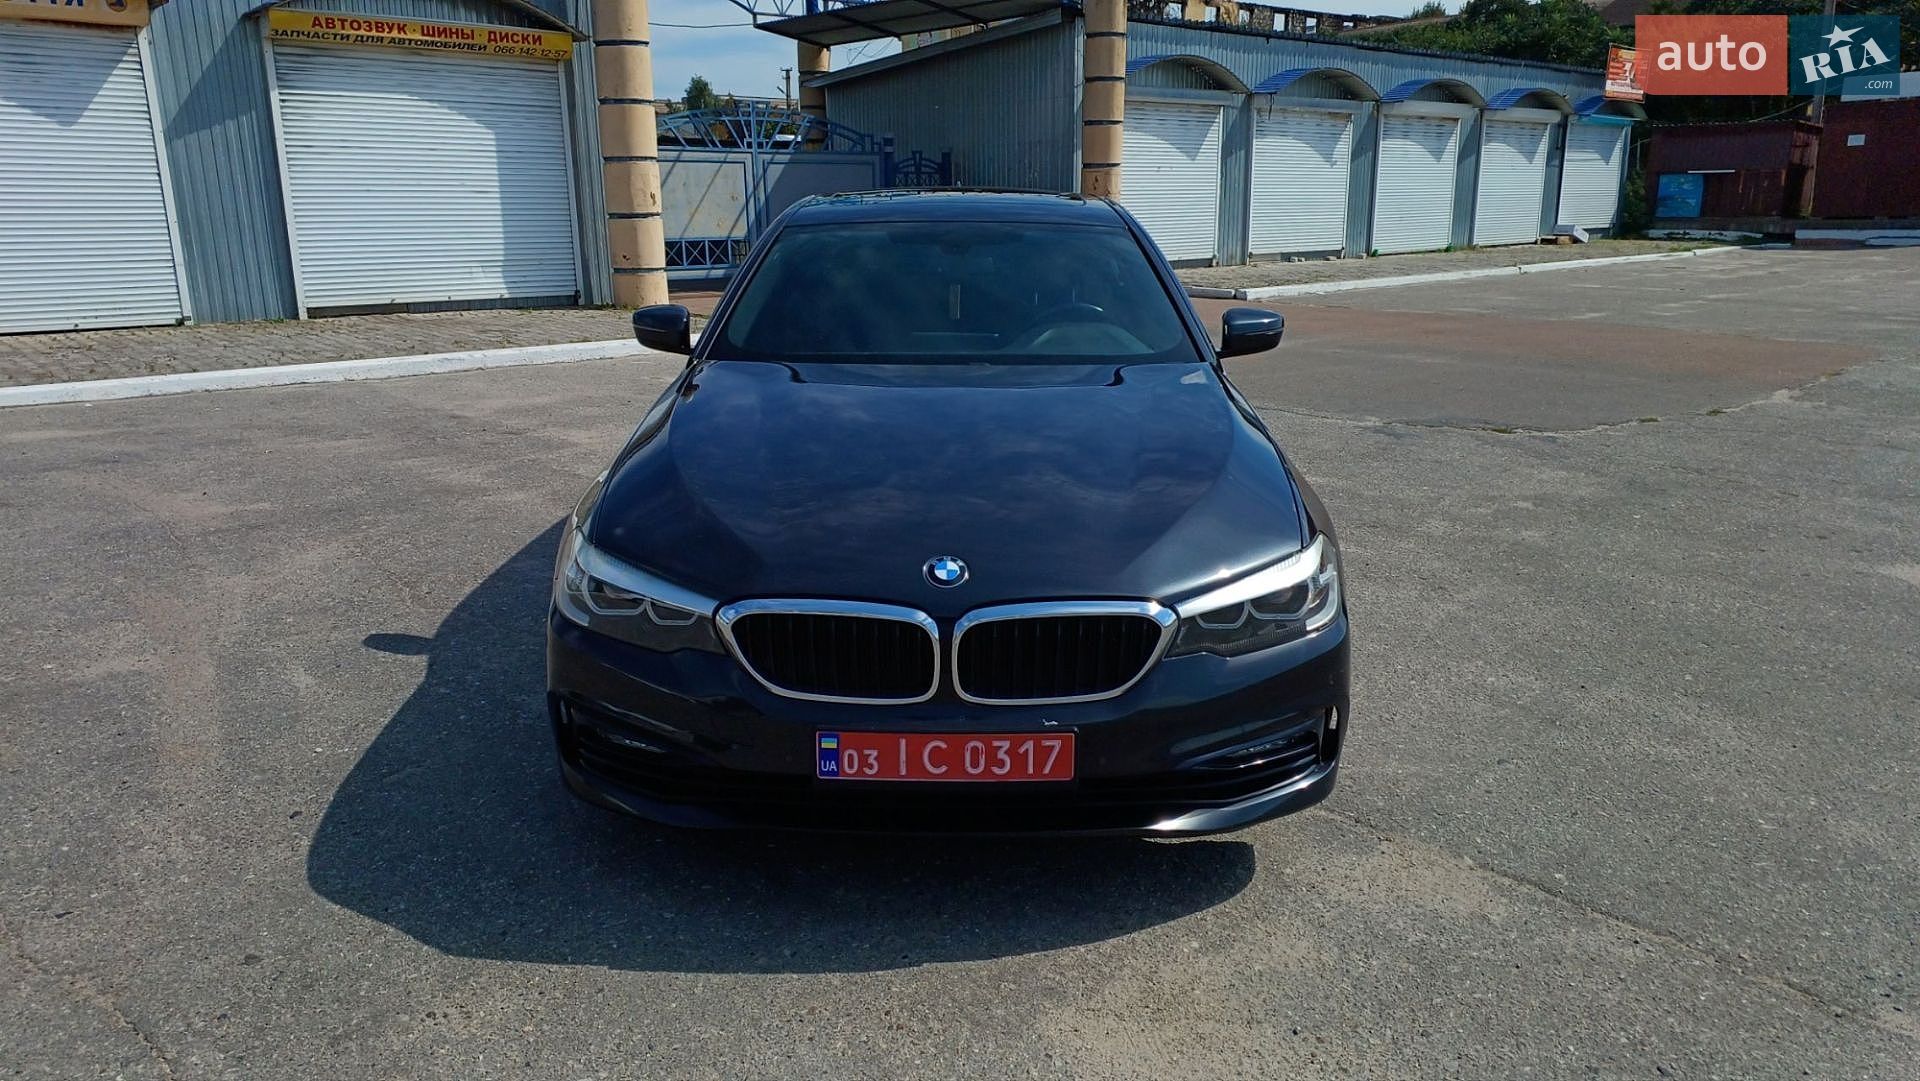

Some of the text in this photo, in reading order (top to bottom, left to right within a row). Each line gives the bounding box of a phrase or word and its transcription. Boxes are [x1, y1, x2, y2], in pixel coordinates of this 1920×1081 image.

[271, 29, 350, 42] ЗАПЧАСТИ
[353, 35, 384, 45] ДЛЯ
[311, 16, 542, 46] АВТОЗВУК ШИНЫ ДИСКИ
[820, 759, 837, 772] UA
[842, 749, 880, 774] 03
[964, 740, 1062, 775] 0317
